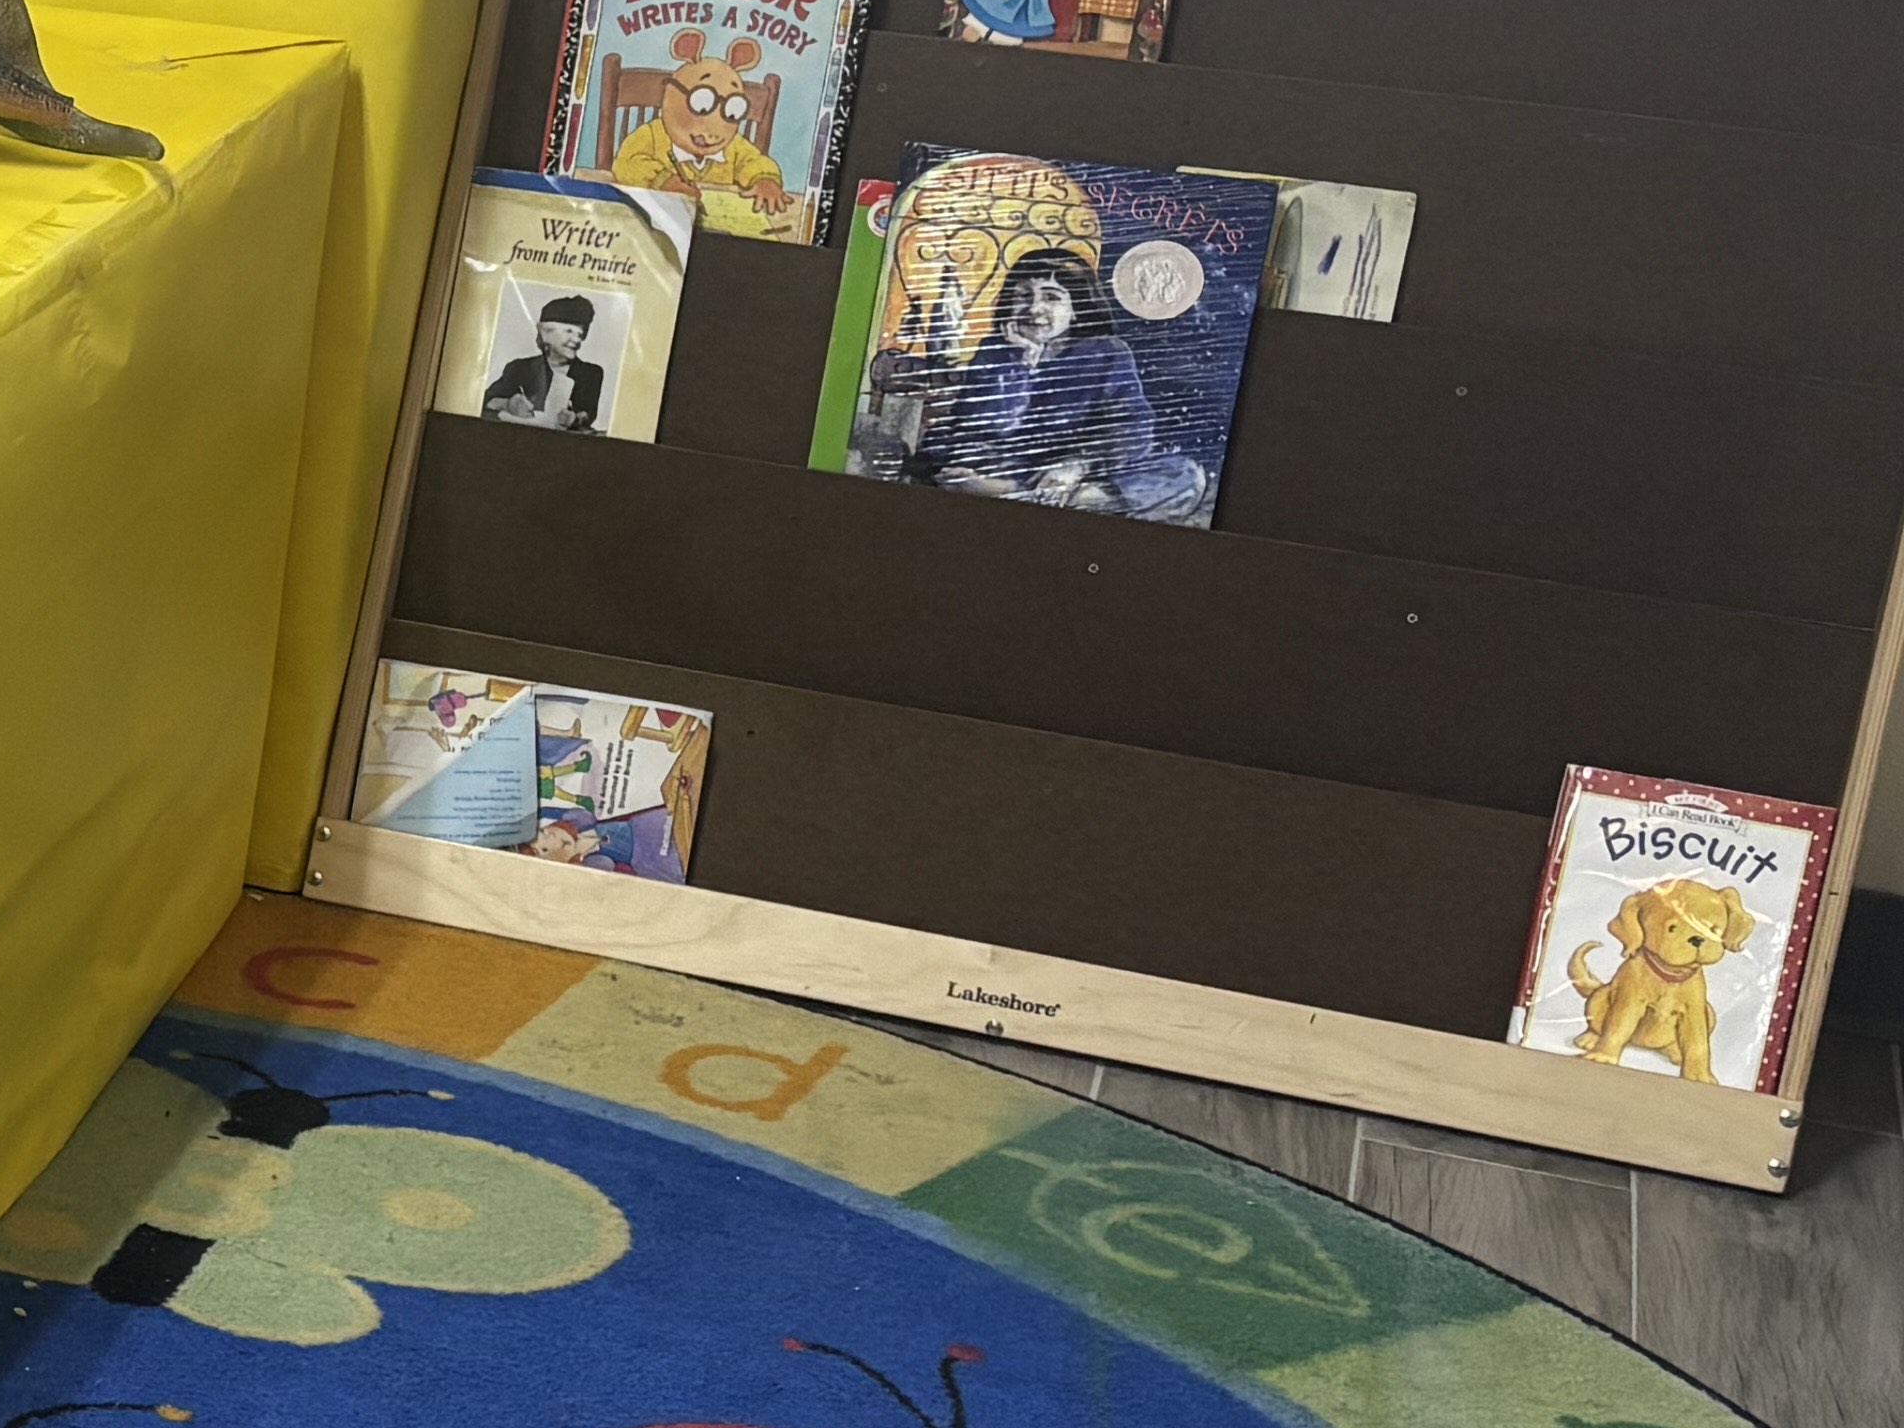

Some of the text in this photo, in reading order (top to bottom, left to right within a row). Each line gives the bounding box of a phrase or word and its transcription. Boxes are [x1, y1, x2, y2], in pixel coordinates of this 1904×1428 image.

[617, 1, 819, 56] WRITES A STORY
[541, 217, 621, 250] Writer
[503, 239, 637, 275] from the Prairie
[1656, 806, 1679, 818] Can
[1682, 809, 1708, 824] Read
[1599, 816, 1778, 884] Biscuit
[947, 980, 1059, 1018] Lakeshore
